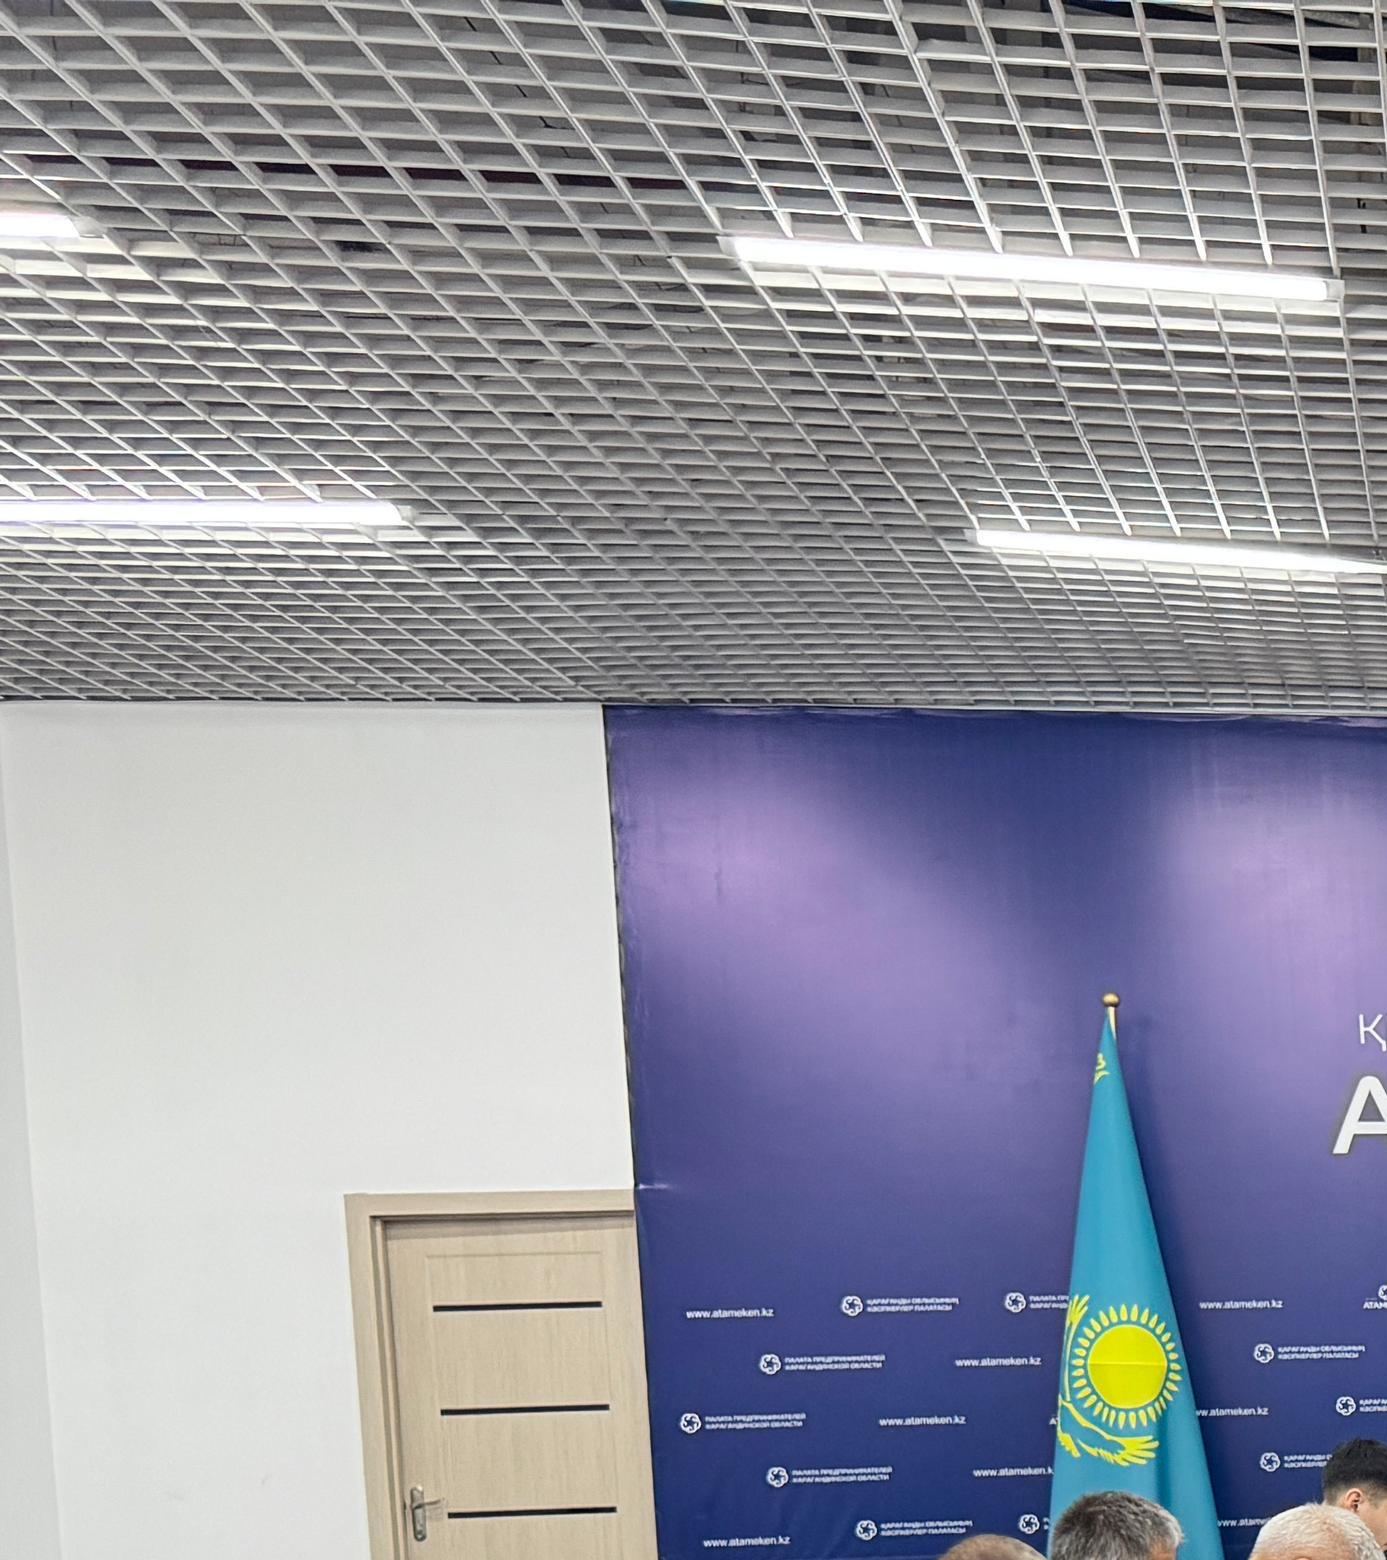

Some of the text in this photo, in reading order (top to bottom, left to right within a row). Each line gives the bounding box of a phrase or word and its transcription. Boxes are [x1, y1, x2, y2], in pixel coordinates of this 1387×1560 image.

[1199, 1299, 1284, 1309] www.atameken.kz
[686, 1308, 775, 1319] www.atameken.kz
[955, 1356, 1043, 1367] www.atameken.kz
[878, 1415, 967, 1426] www.atameken.kz
[702, 1535, 792, 1547] www.atameken.kz
